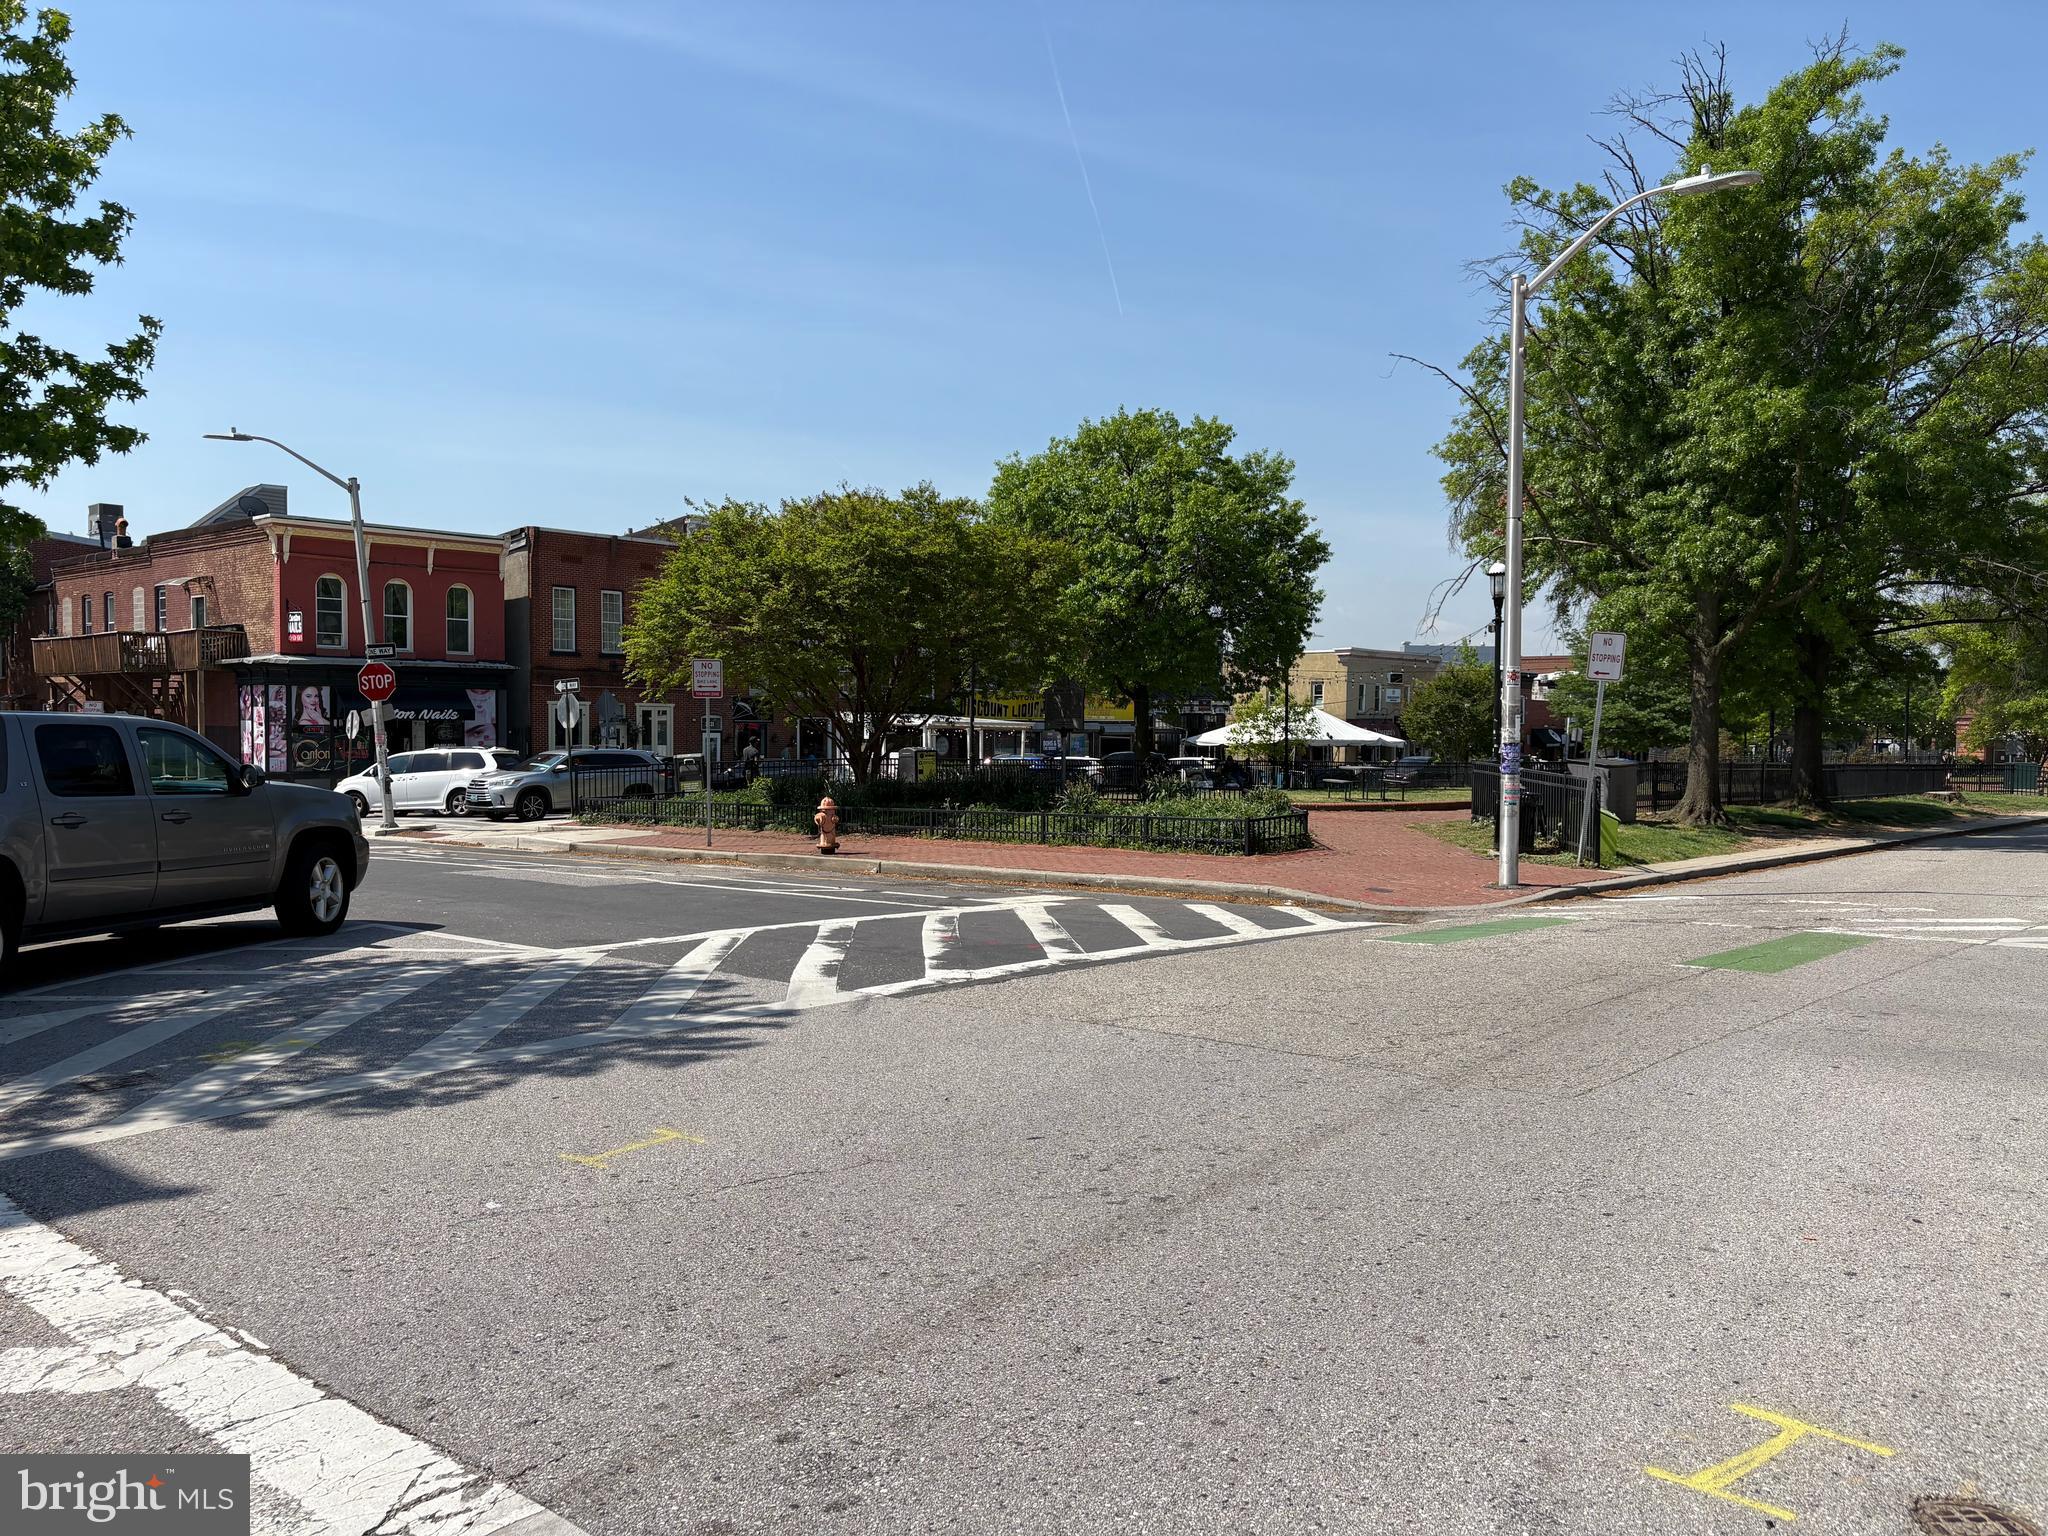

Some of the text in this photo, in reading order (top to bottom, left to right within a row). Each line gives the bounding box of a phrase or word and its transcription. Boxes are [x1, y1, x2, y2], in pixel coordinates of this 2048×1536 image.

[1603, 638, 1613, 646] NO
[1592, 654, 1620, 663] STOPPING
[701, 662, 713, 670] NO
[361, 674, 392, 690] STOP
[393, 709, 460, 720] ton Nails
